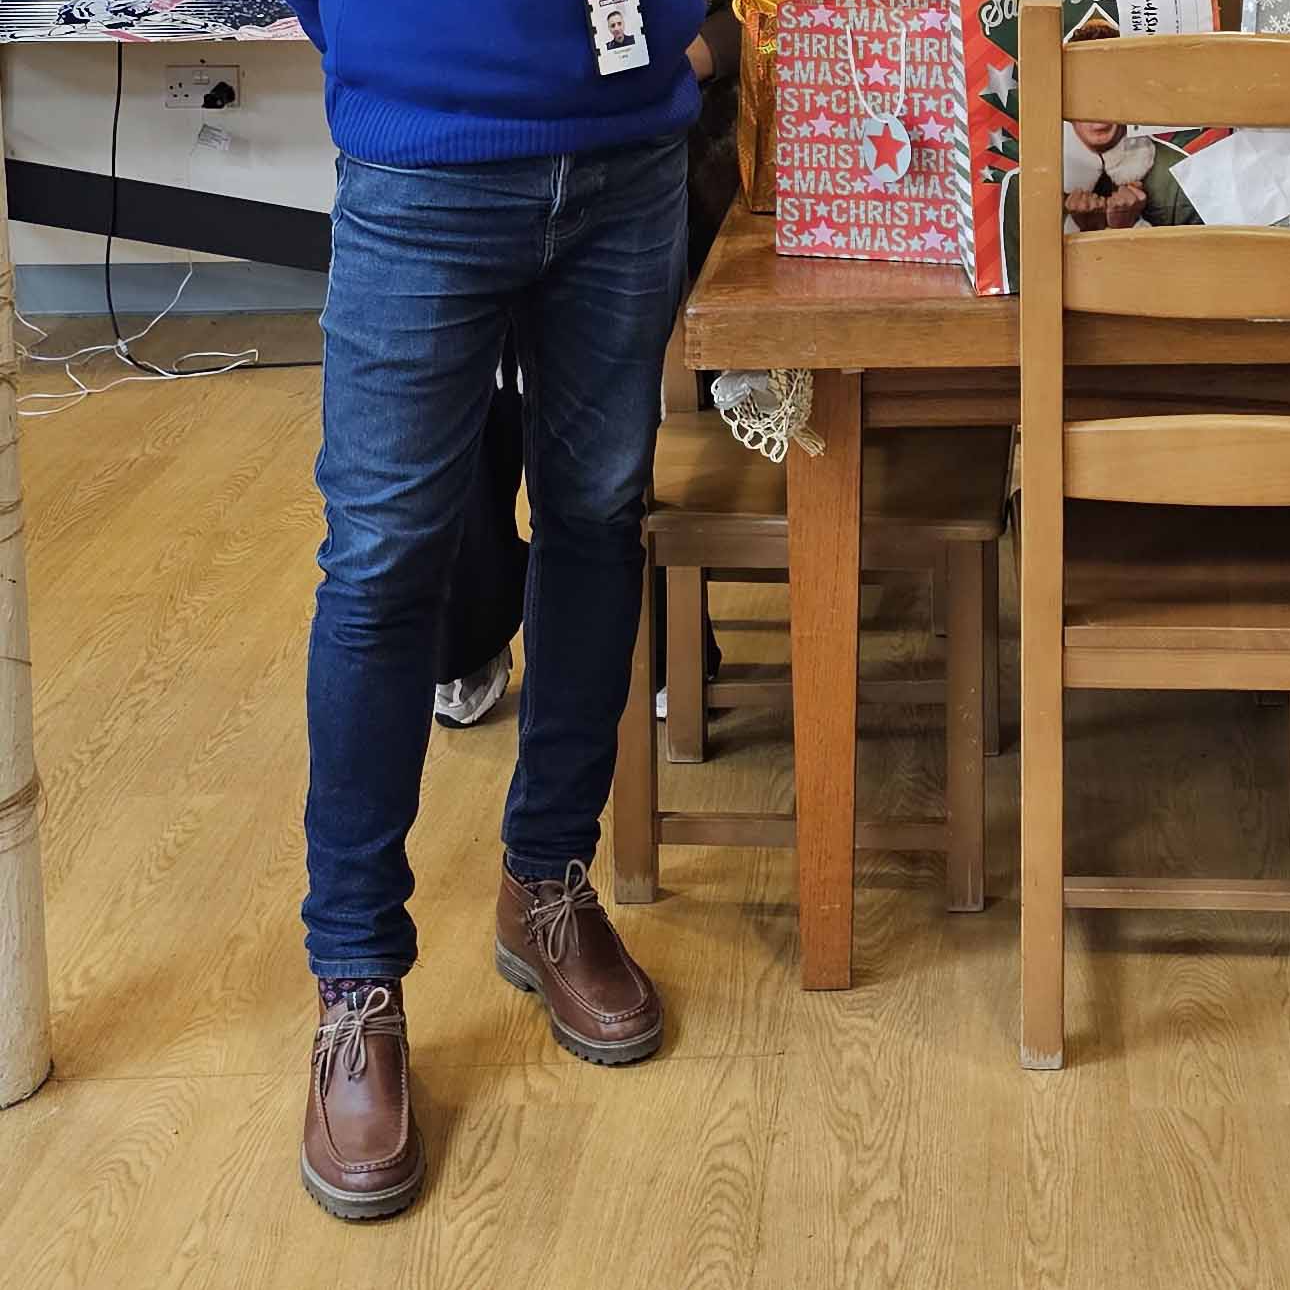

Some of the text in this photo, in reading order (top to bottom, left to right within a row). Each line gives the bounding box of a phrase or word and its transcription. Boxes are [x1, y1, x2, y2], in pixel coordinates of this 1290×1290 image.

[850, 8, 906, 33] MAS
[1131, 4, 1143, 32] MERRY
[776, 33, 869, 59] CHRIST
[793, 60, 851, 86] MAS
[831, 88, 925, 117] CHRIST
[793, 170, 958, 199] MAS MAS
[831, 199, 925, 226] CHRIST
[850, 227, 907, 253] MAS
